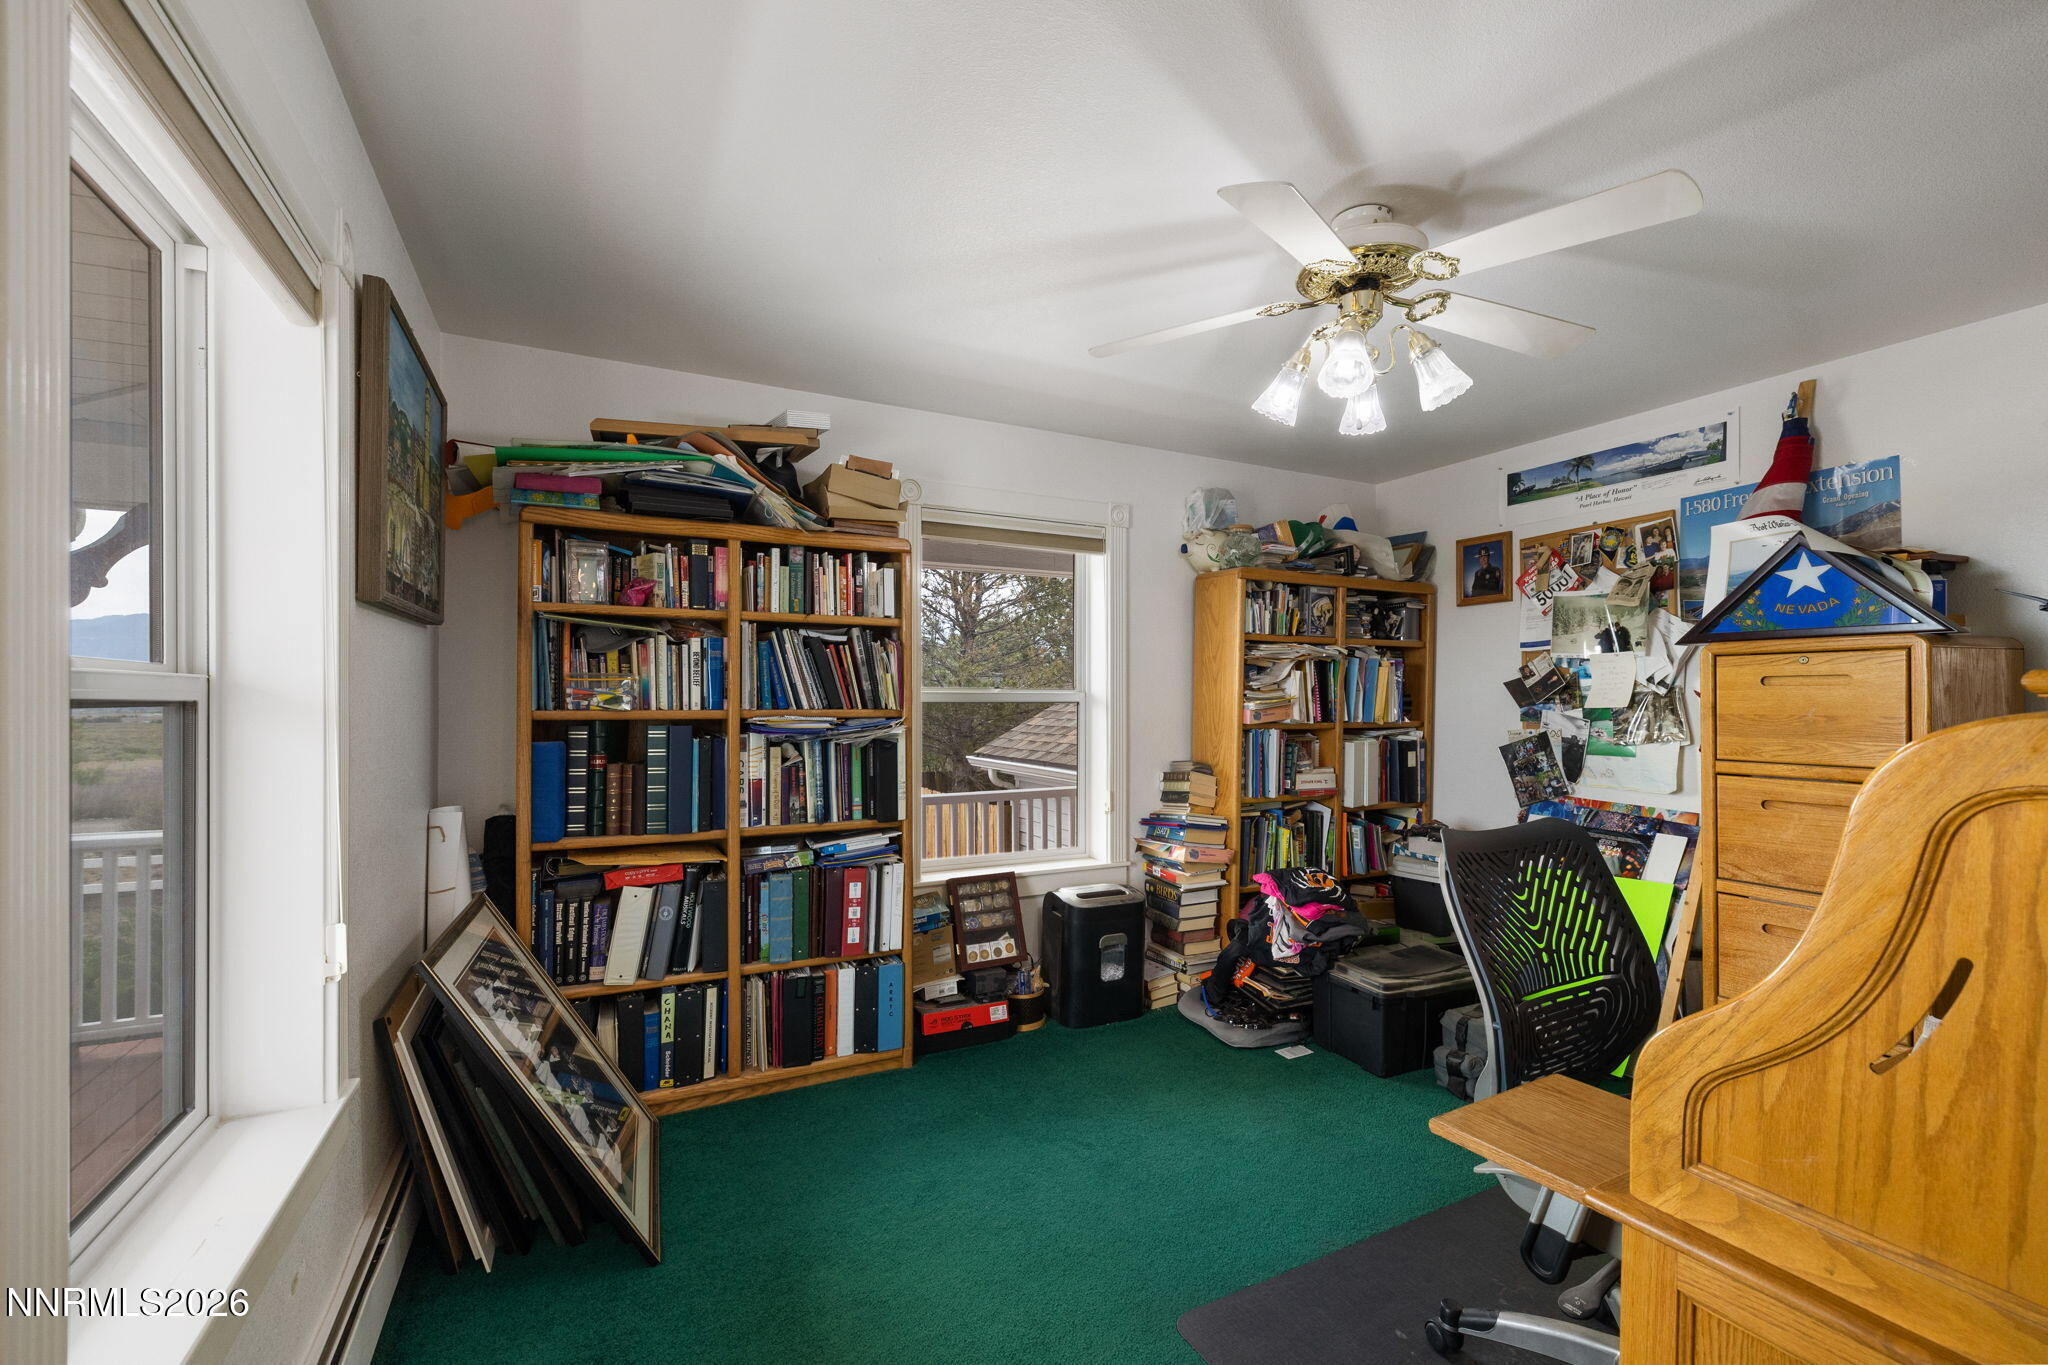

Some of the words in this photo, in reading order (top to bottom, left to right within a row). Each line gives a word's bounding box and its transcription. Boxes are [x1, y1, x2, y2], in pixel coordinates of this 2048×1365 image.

[1805, 466, 1894, 494] xtension
[1686, 495, 1721, 516] I-580
[1823, 494, 1841, 504] Grand
[1843, 490, 1869, 501] Opening
[1774, 597, 1841, 615] NEVADA
[692, 651, 700, 669] BEYOND
[692, 670, 700, 687] BELIEF
[1156, 883, 1178, 901] BIRDS
[556, 903, 564, 921] Street
[568, 903, 577, 926] Tactical
[680, 895, 690, 925] MUSICALS
[685, 892, 696, 929] HOLLYWOOD
[555, 921, 564, 945] Survival
[567, 928, 576, 942] Edge
[664, 998, 672, 1040] CHANA
[815, 995, 824, 1047] CHEMISTRY
